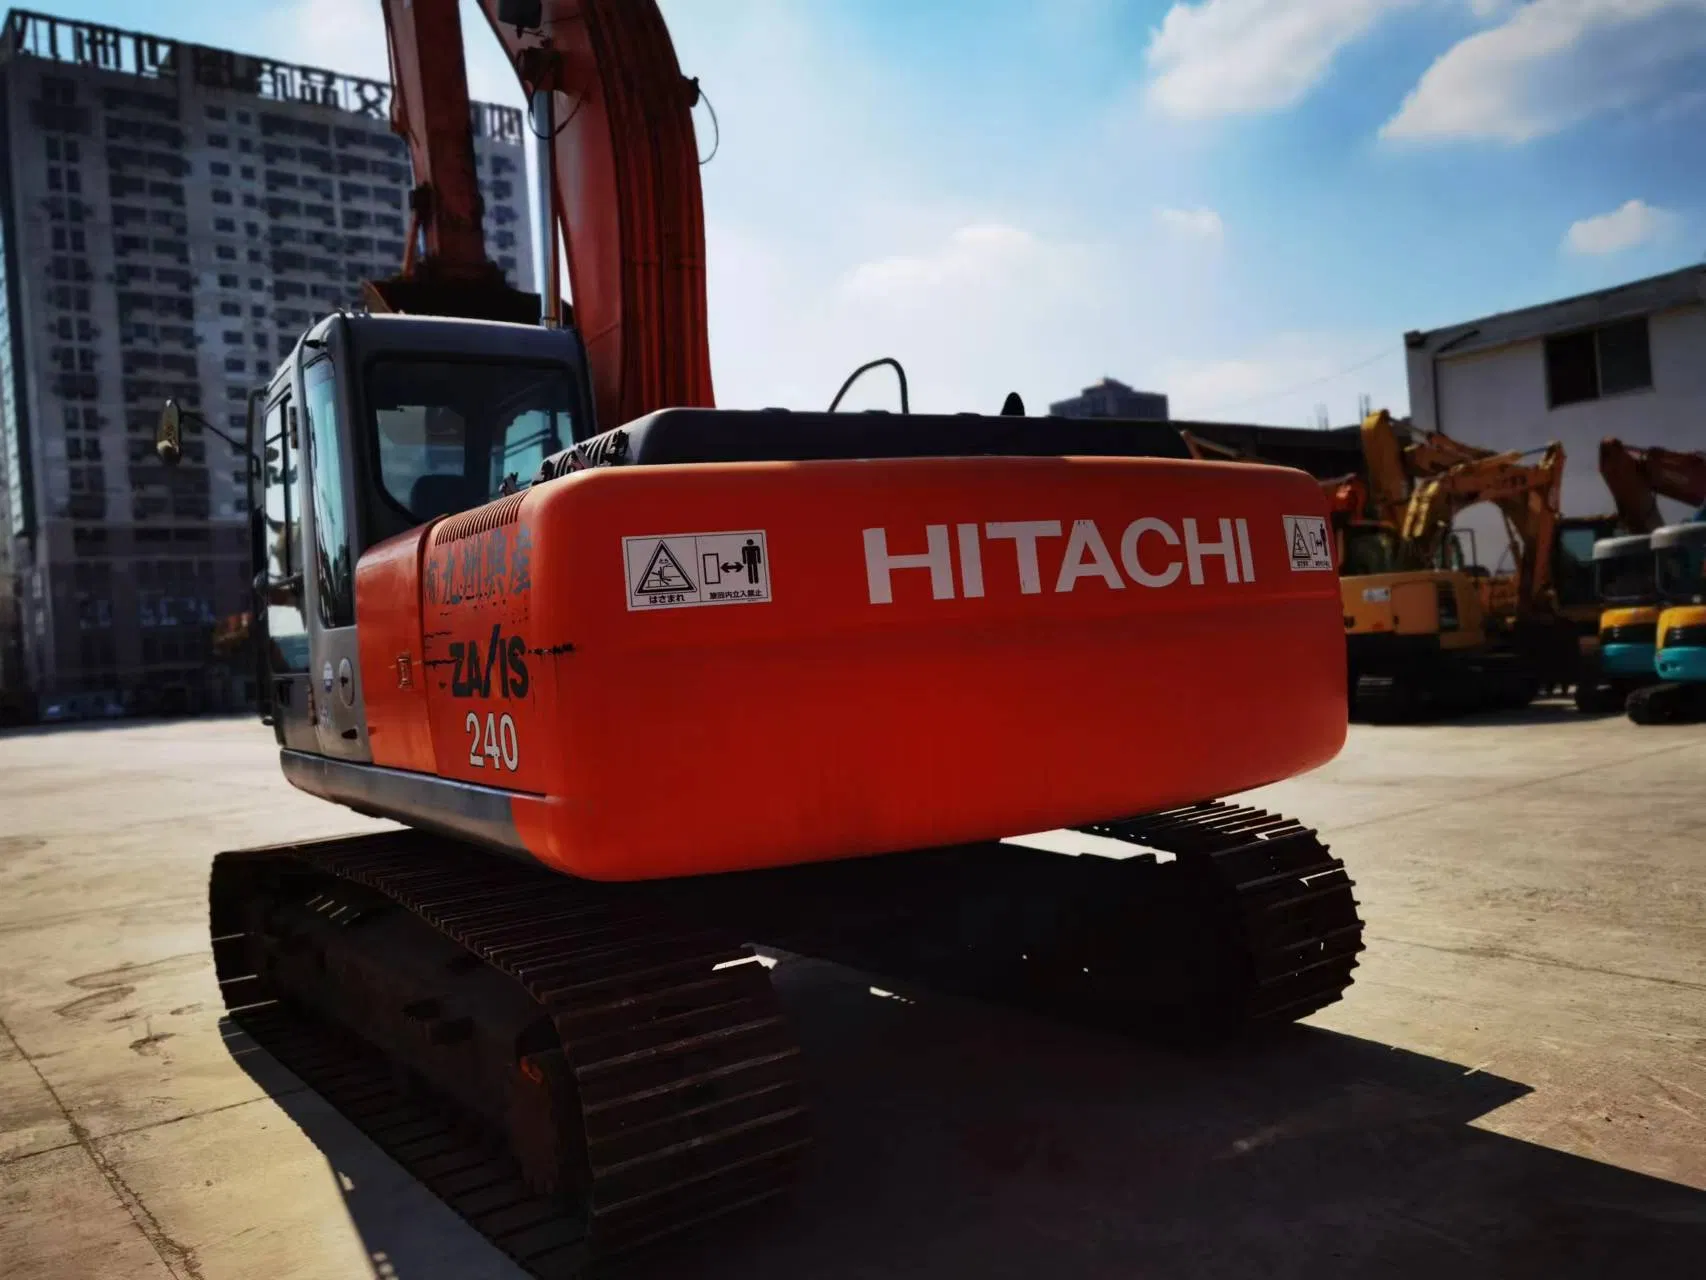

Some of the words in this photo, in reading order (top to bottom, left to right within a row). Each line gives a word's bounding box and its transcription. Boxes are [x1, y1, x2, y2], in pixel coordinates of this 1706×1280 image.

[862, 517, 1256, 604] HITACHI
[649, 594, 686, 604] はさまれ
[466, 712, 518, 772] 240
